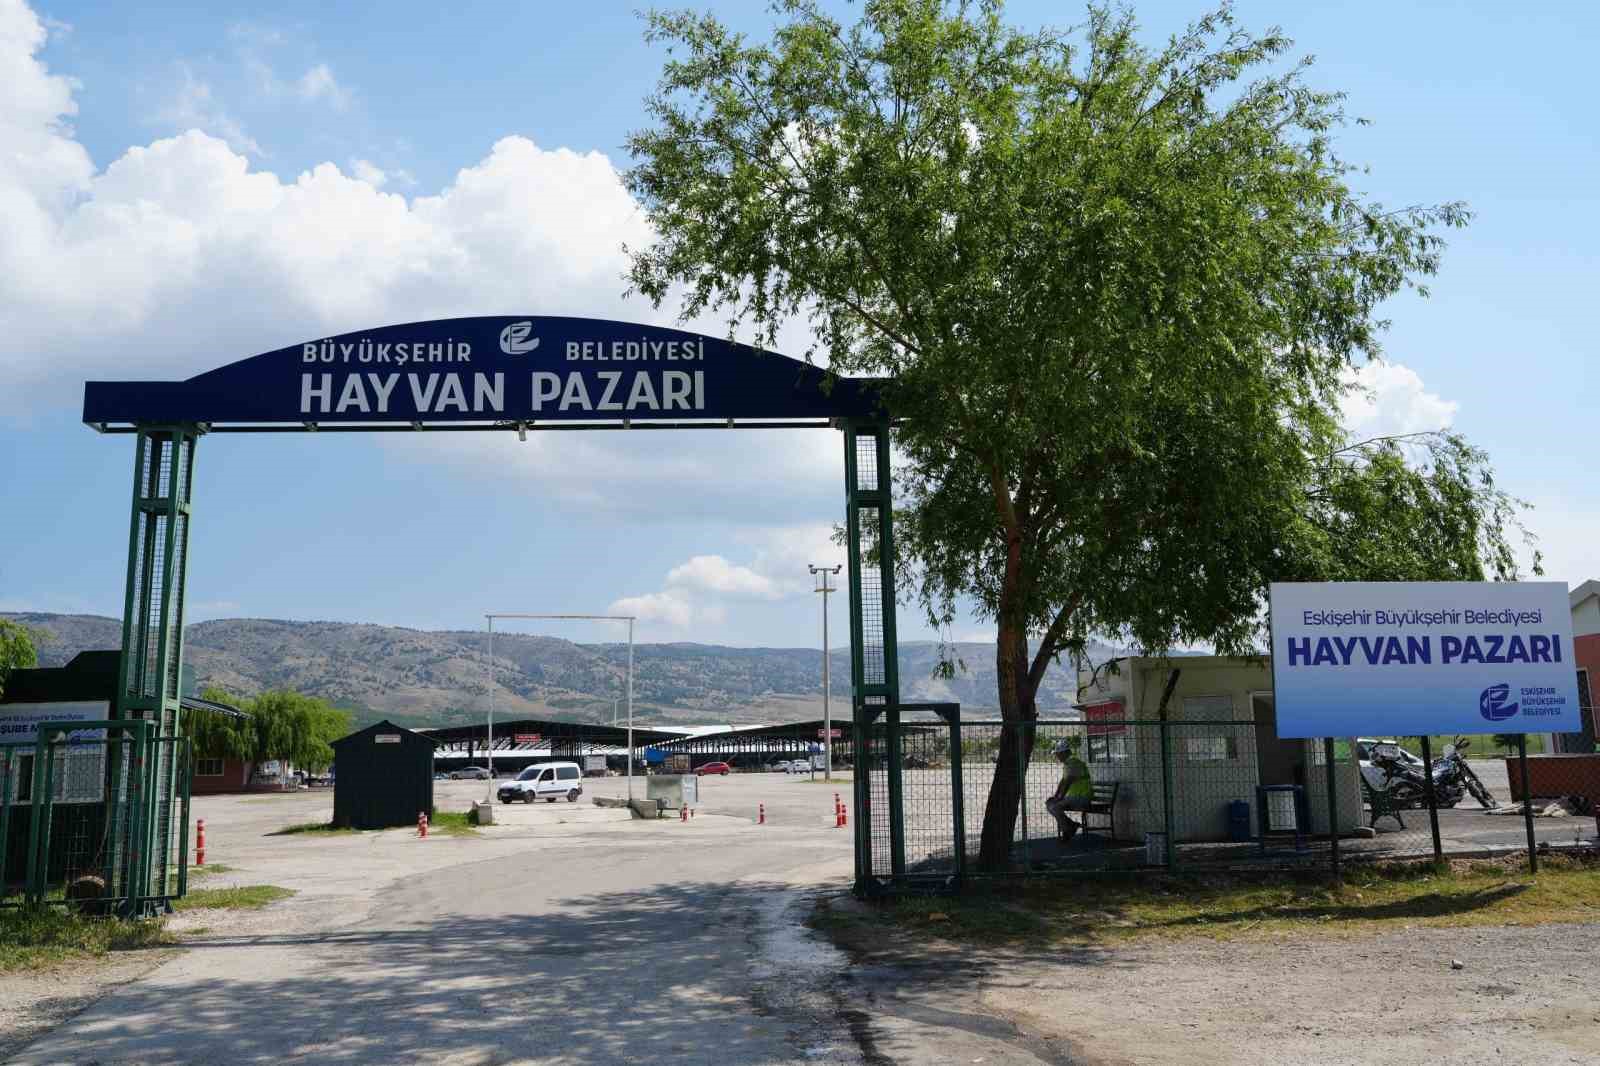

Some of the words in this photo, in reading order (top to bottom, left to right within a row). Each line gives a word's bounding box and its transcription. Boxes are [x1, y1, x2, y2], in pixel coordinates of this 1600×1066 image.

[303, 338, 471, 365] BÜYÜKŞEHİR
[566, 336, 704, 361] BELEDİYESİ
[300, 373, 505, 413] HAYVAN
[531, 371, 705, 411] PAZARI
[1303, 609, 1372, 627] Eskişehir
[1375, 608, 1462, 627] Büyükşehir
[1464, 608, 1542, 627] Belediyesi
[1287, 636, 1432, 666] HAYVAN
[1440, 634, 1562, 665] PAZARI
